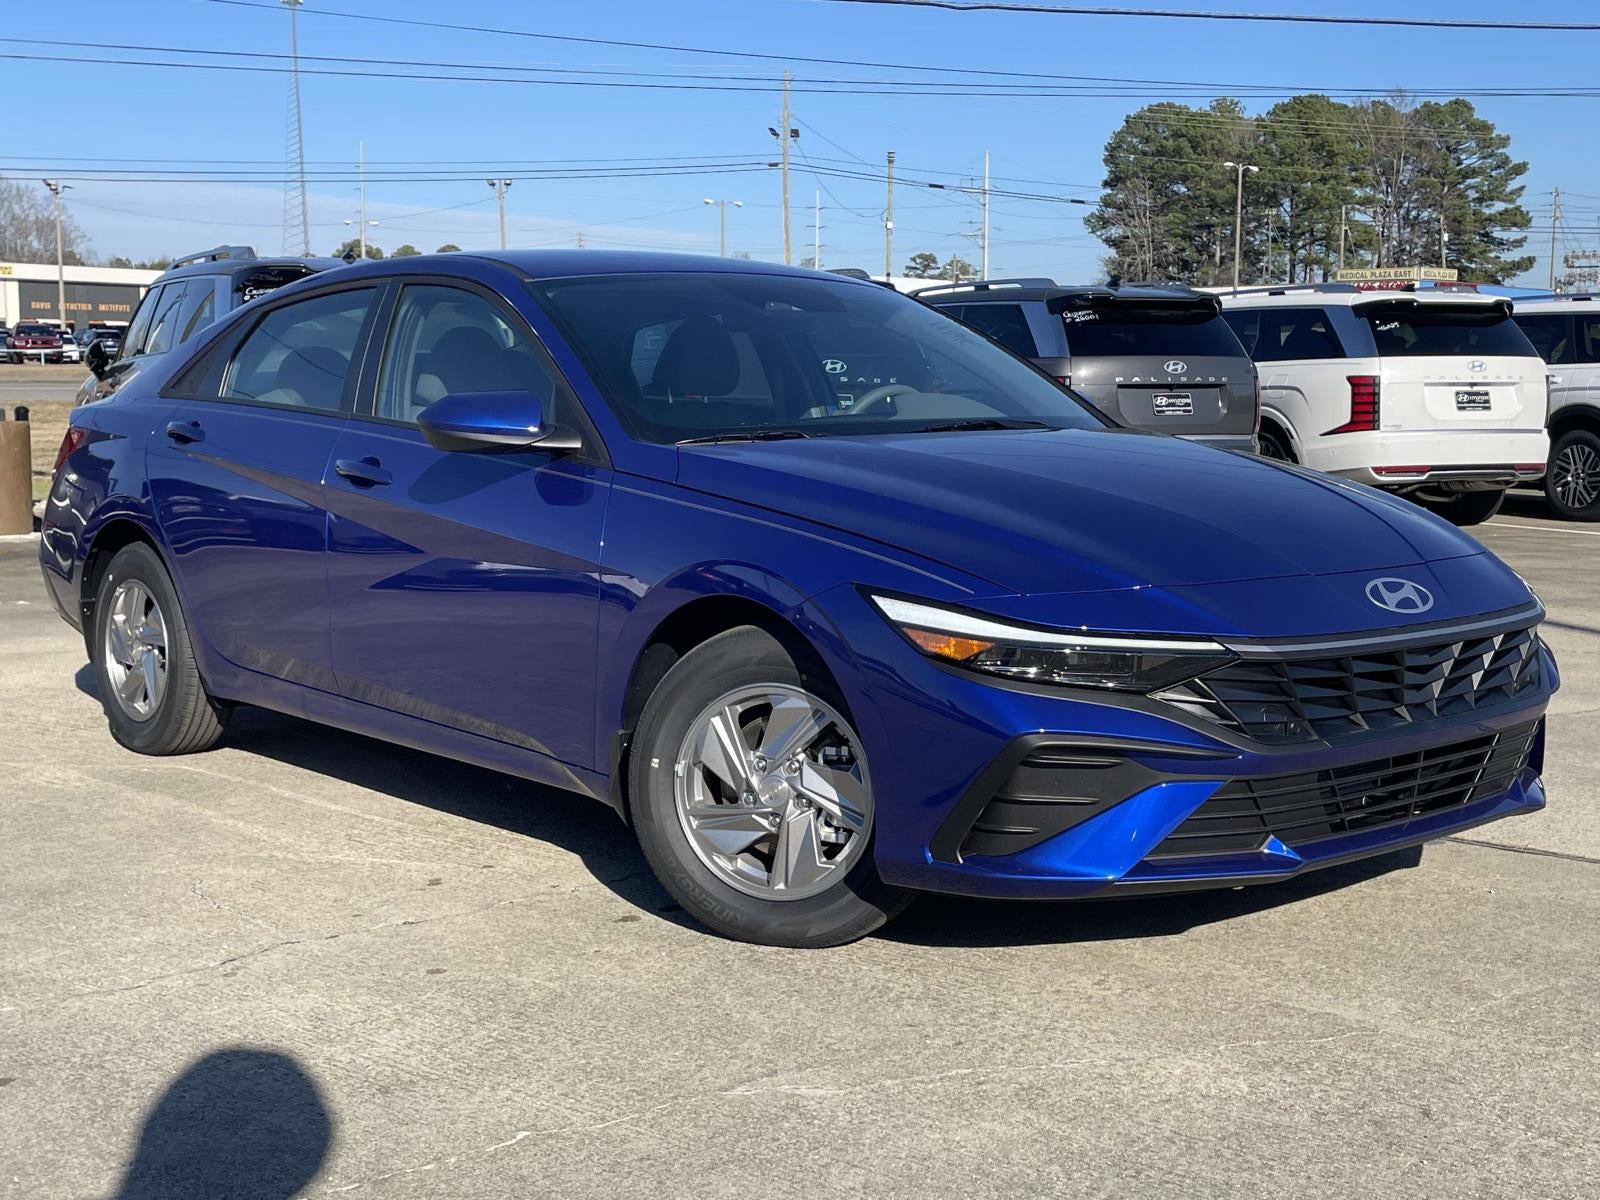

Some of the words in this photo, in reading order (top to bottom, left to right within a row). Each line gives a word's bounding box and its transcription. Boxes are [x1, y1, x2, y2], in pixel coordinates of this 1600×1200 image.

[31, 302, 51, 310] DAVIS
[59, 303, 92, 311] STHETICS
[98, 304, 130, 312] INSTITUTE
